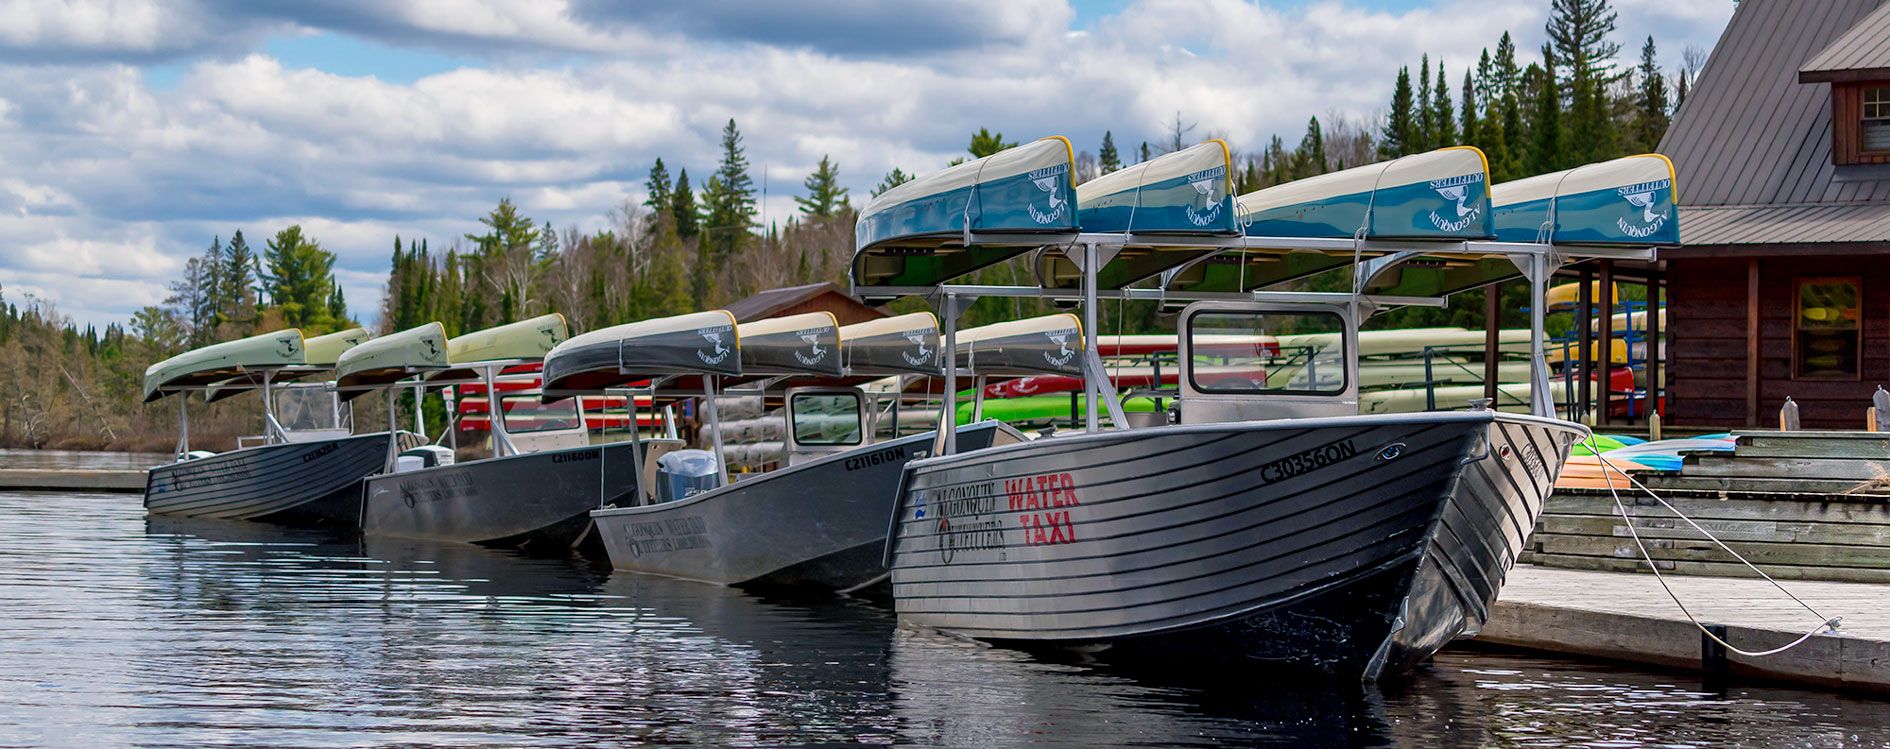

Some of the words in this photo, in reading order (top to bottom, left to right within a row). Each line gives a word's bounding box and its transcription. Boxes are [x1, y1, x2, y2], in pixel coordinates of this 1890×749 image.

[1028, 162, 1070, 180] OUTFITTERS
[1430, 173, 1483, 189] OUTFITTERS
[1617, 178, 1670, 196] OUTFITTERS
[1027, 195, 1068, 225] ALGONQUIN
[1186, 197, 1223, 226] ALGONQUIN
[1429, 203, 1480, 231] ALGONQUIN
[1617, 209, 1667, 238] ALGONQUIN
[845, 447, 905, 471] C21161ON
[1261, 439, 1357, 484] C30356ON
[936, 482, 996, 519] ALGONQUIN
[1005, 472, 1080, 512] WATER
[939, 518, 1005, 563] OUTFITTERS
[1020, 510, 1077, 546] TAXI
